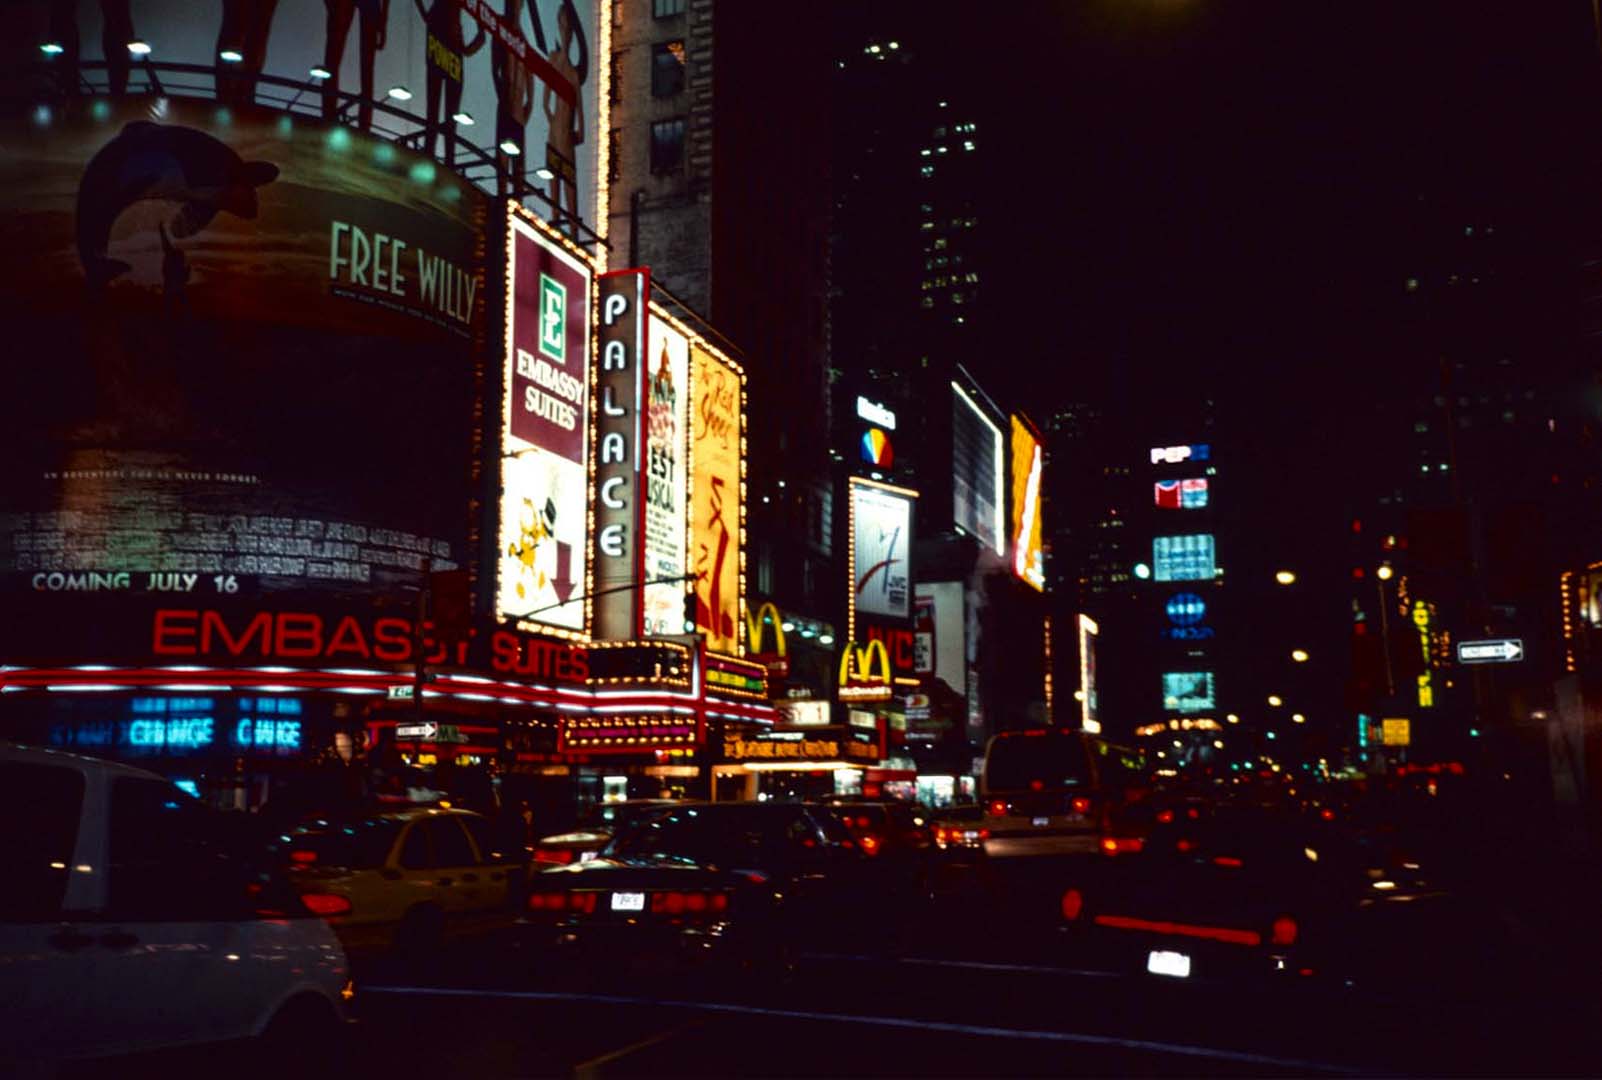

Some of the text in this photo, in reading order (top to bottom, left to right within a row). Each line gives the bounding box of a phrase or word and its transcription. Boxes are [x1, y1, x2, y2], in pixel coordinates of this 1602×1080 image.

[428, 32, 462, 82] POWER
[329, 220, 407, 297] FREE
[417, 247, 478, 325] WILLY
[517, 348, 584, 405] EMBASSY
[525, 385, 577, 431] SUITES
[600, 292, 627, 558] PALACE
[649, 446, 675, 483] EST
[31, 571, 240, 594] COMING JULY 16
[490, 629, 590, 683] SUITES
